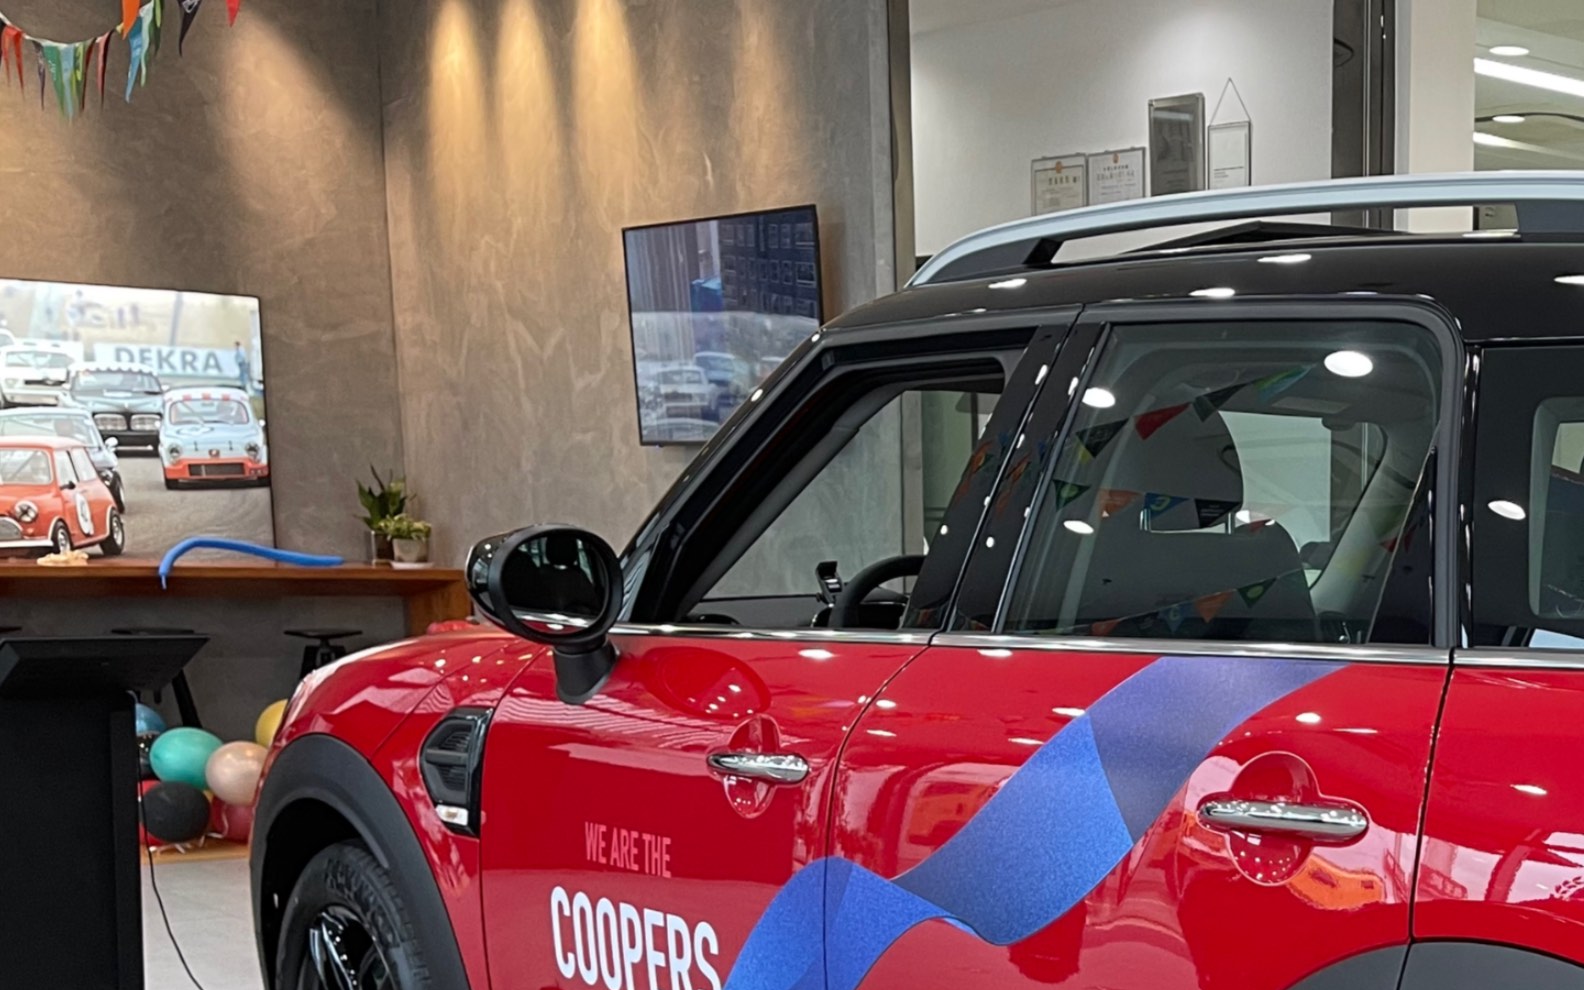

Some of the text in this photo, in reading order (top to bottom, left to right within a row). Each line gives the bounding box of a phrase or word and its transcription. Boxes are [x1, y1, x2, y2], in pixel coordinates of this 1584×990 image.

[114, 346, 223, 373] DEKRA
[584, 821, 672, 878] WE ARE THE
